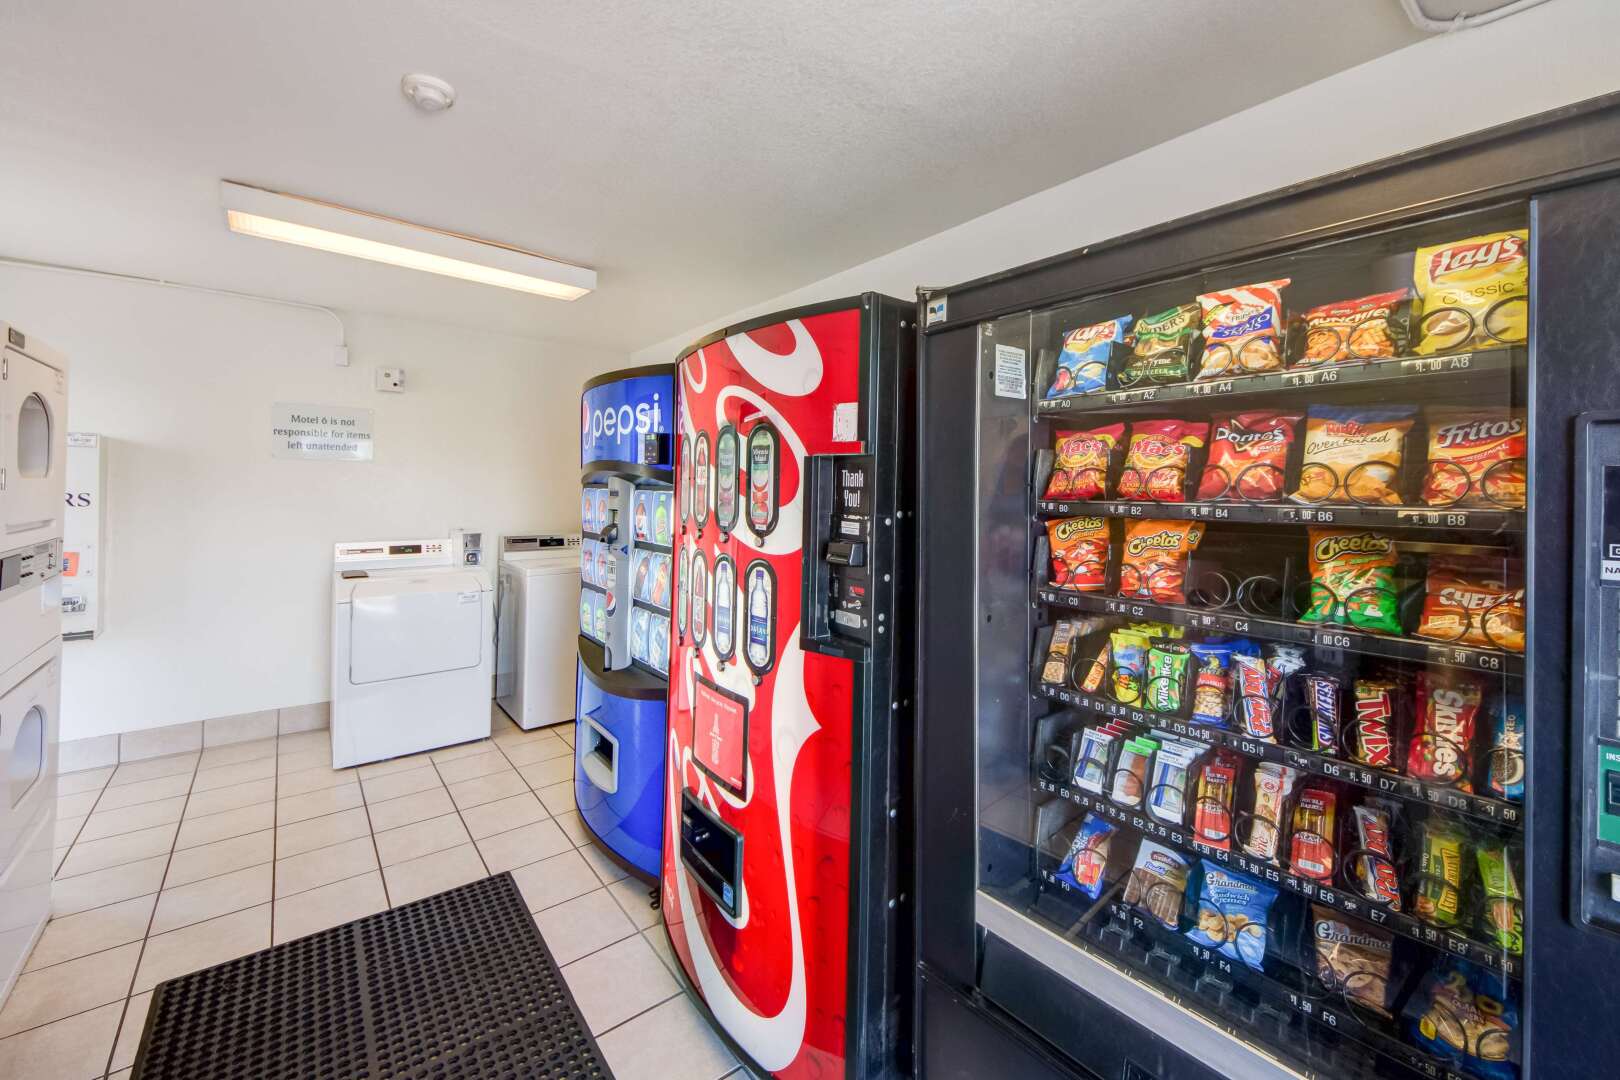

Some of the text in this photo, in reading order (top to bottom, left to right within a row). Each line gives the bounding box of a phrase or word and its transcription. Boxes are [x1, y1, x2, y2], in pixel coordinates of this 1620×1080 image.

[1443, 281, 1514, 304] Cssic
[1321, 371, 1337, 381] A6
[1219, 382, 1232, 392] A4
[1143, 391, 1155, 399] A2
[291, 415, 319, 425] Motel
[331, 416, 338, 425] is
[340, 417, 355, 426] not
[593, 393, 660, 446] pepsi
[273, 428, 371, 440] responsible for items
[1216, 427, 1285, 443] Doritos
[1438, 419, 1522, 448] Fritos
[288, 441, 358, 452] left unattended
[842, 469, 864, 488] Thank
[844, 490, 861, 508] You!
[1215, 508, 1229, 518] B4
[1318, 511, 1333, 522] B6
[1447, 514, 1466, 526] B8
[1058, 518, 1103, 540] Cheetos
[1129, 531, 1181, 554] Cheetos
[1316, 534, 1390, 561] Cheetos
[1132, 606, 1144, 616] C2
[1235, 621, 1249, 632] C4
[1334, 635, 1350, 647] C6
[1480, 656, 1499, 669] C8
[1132, 711, 1144, 722] D2
[1316, 679, 1337, 746] SNIKERS
[1173, 724, 1186, 734] D3
[1188, 727, 1200, 738] D4
[1355, 691, 1392, 766] TWIX
[1242, 741, 1256, 754] D5
[1323, 763, 1340, 776] D6
[1380, 778, 1397, 791] D7
[1060, 788, 1070, 798] E0
[1095, 803, 1105, 813] E1
[1448, 795, 1467, 810] D8
[1133, 817, 1144, 828] E2
[1171, 832, 1183, 844] E3
[1216, 850, 1229, 862] E4
[1266, 869, 1279, 882] E5
[1209, 888, 1250, 901] Sandwich
[1320, 890, 1335, 903] E6
[1211, 896, 1247, 907] Cremes
[1370, 909, 1386, 923] E7
[1133, 917, 1144, 930] F2
[1448, 938, 1467, 955] E8
[1219, 960, 1231, 974] F4
[1322, 1011, 1337, 1026] F6
